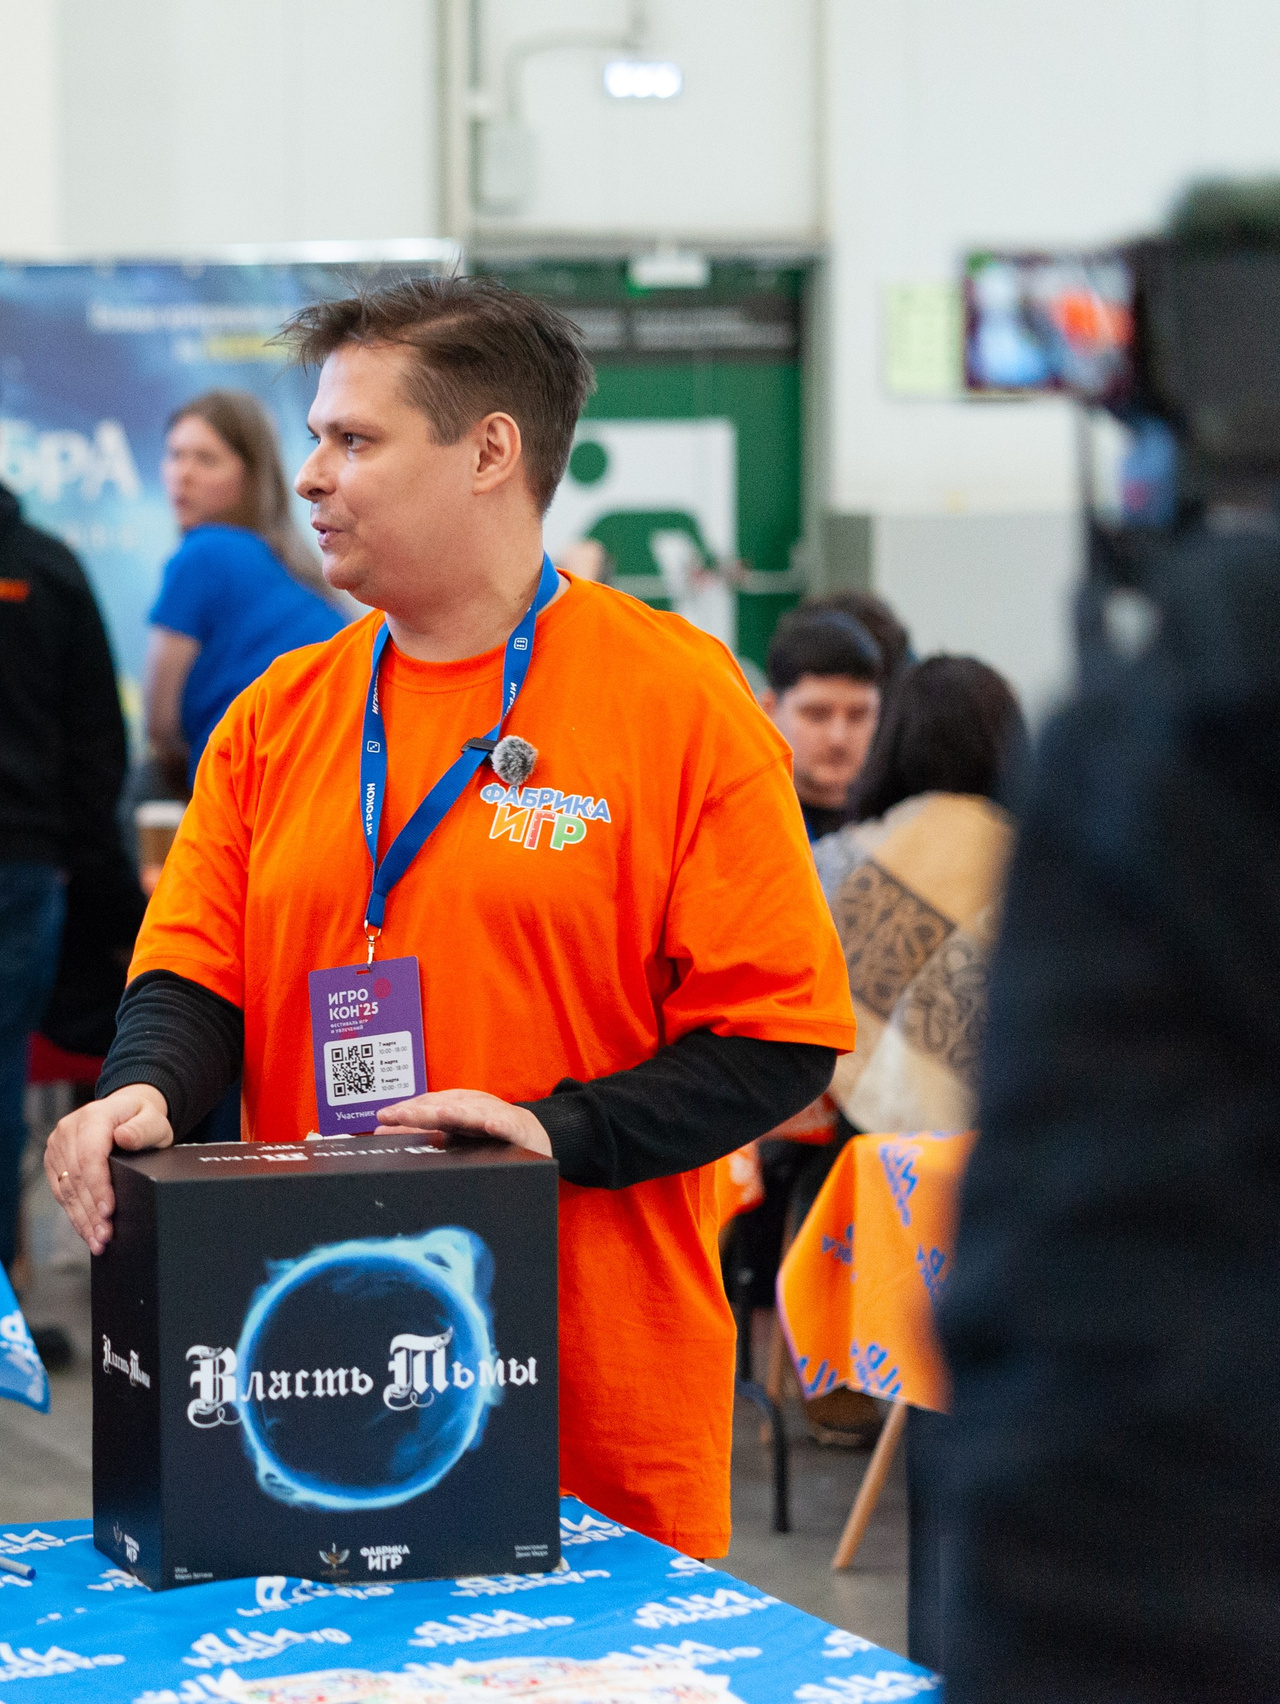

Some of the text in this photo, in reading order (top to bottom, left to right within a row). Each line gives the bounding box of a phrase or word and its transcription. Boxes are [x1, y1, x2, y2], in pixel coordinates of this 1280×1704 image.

[366, 782, 376, 836] ИГРОКОН
[480, 783, 612, 823] ФАБРИКА
[488, 805, 587, 851] ИГР
[328, 988, 369, 1006] ИГРО
[335, 1110, 376, 1121] Участник
[185, 1325, 539, 1429] Власть Тьмы
[360, 1544, 411, 1558] ФАБРИКА
[367, 1553, 403, 1572] ИГР
